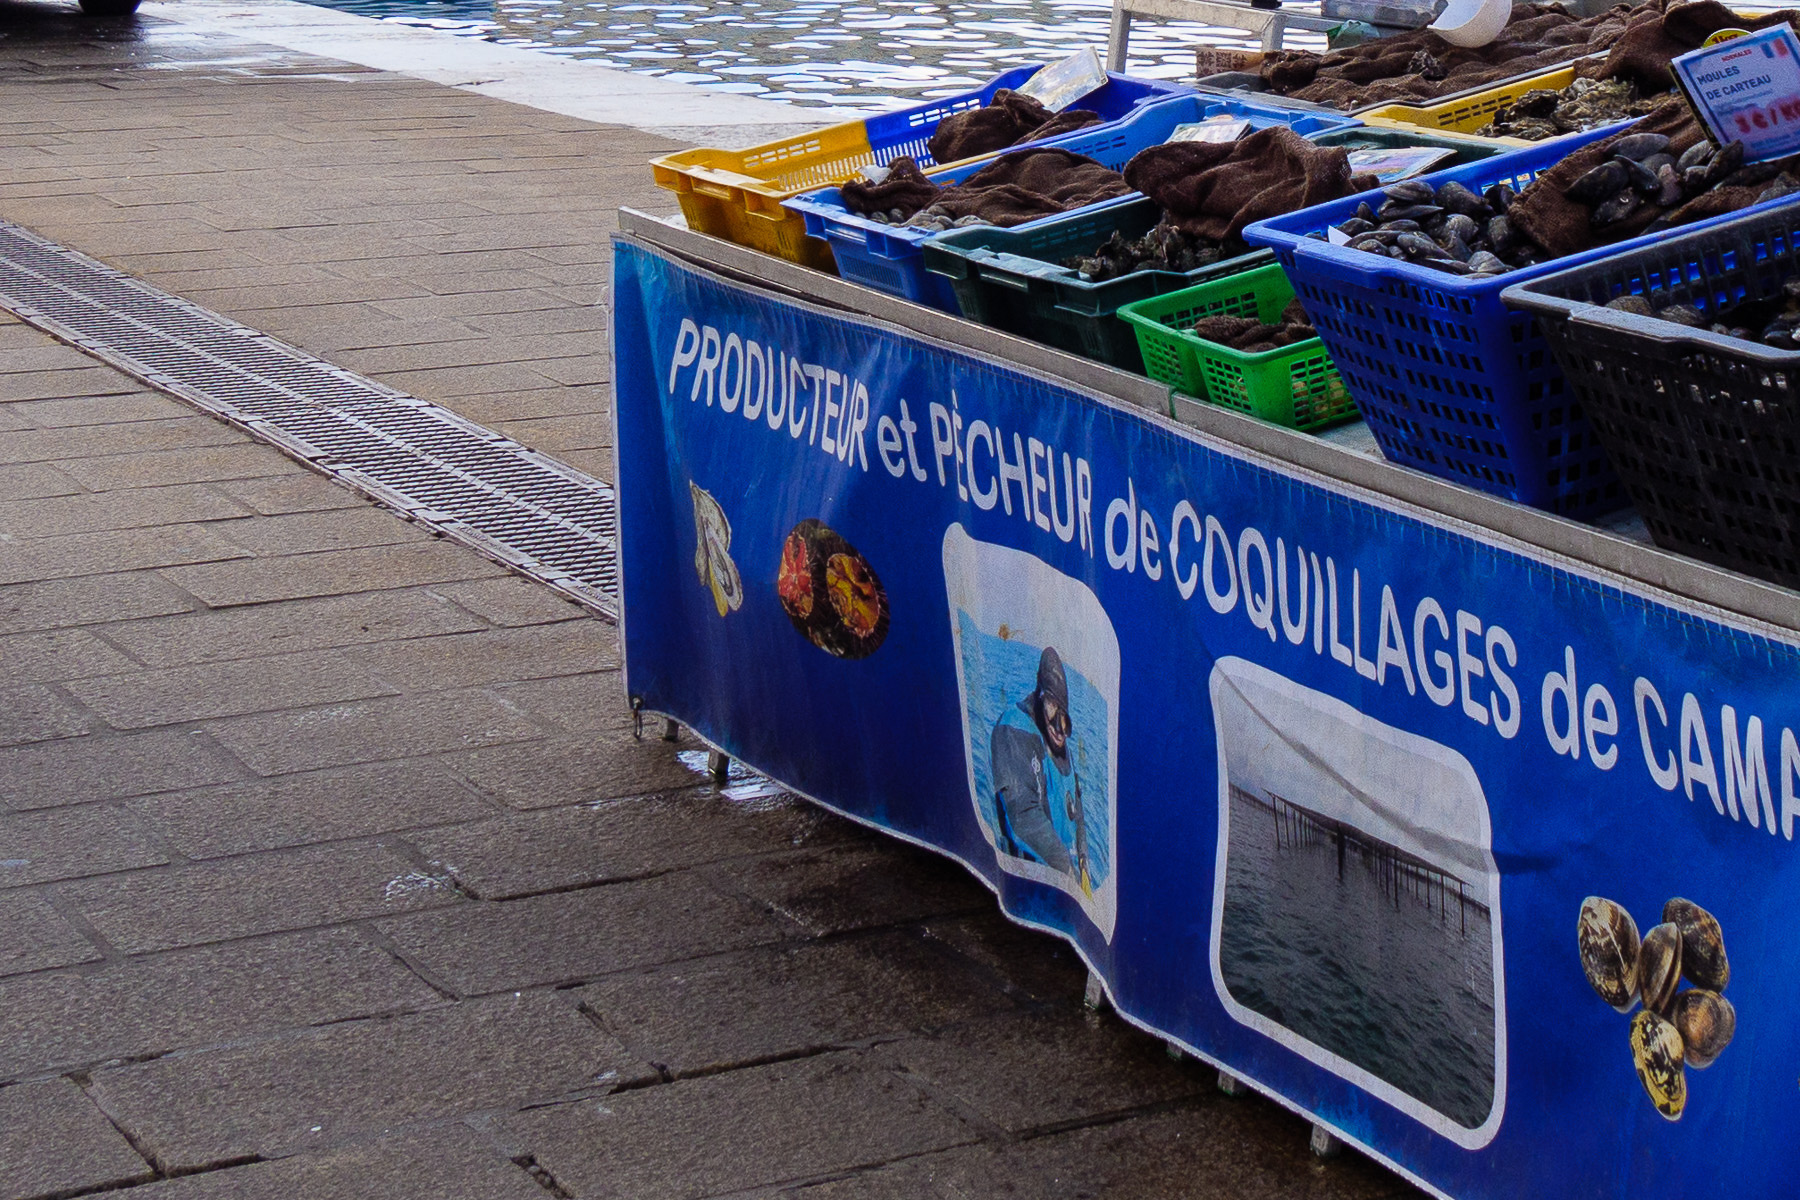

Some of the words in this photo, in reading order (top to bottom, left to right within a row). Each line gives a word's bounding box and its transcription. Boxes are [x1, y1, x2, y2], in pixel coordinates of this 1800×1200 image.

[1697, 65, 1740, 85] MOULES
[1705, 89, 1722, 100] DE
[1722, 74, 1772, 95] CARTEAU
[669, 318, 870, 472] PRODUCTEUR
[877, 398, 927, 482] et
[930, 388, 1095, 559] PÊCHEUR
[1104, 477, 1163, 582] de
[1169, 499, 1521, 740] COQUILLAGES
[1541, 645, 1619, 770] de
